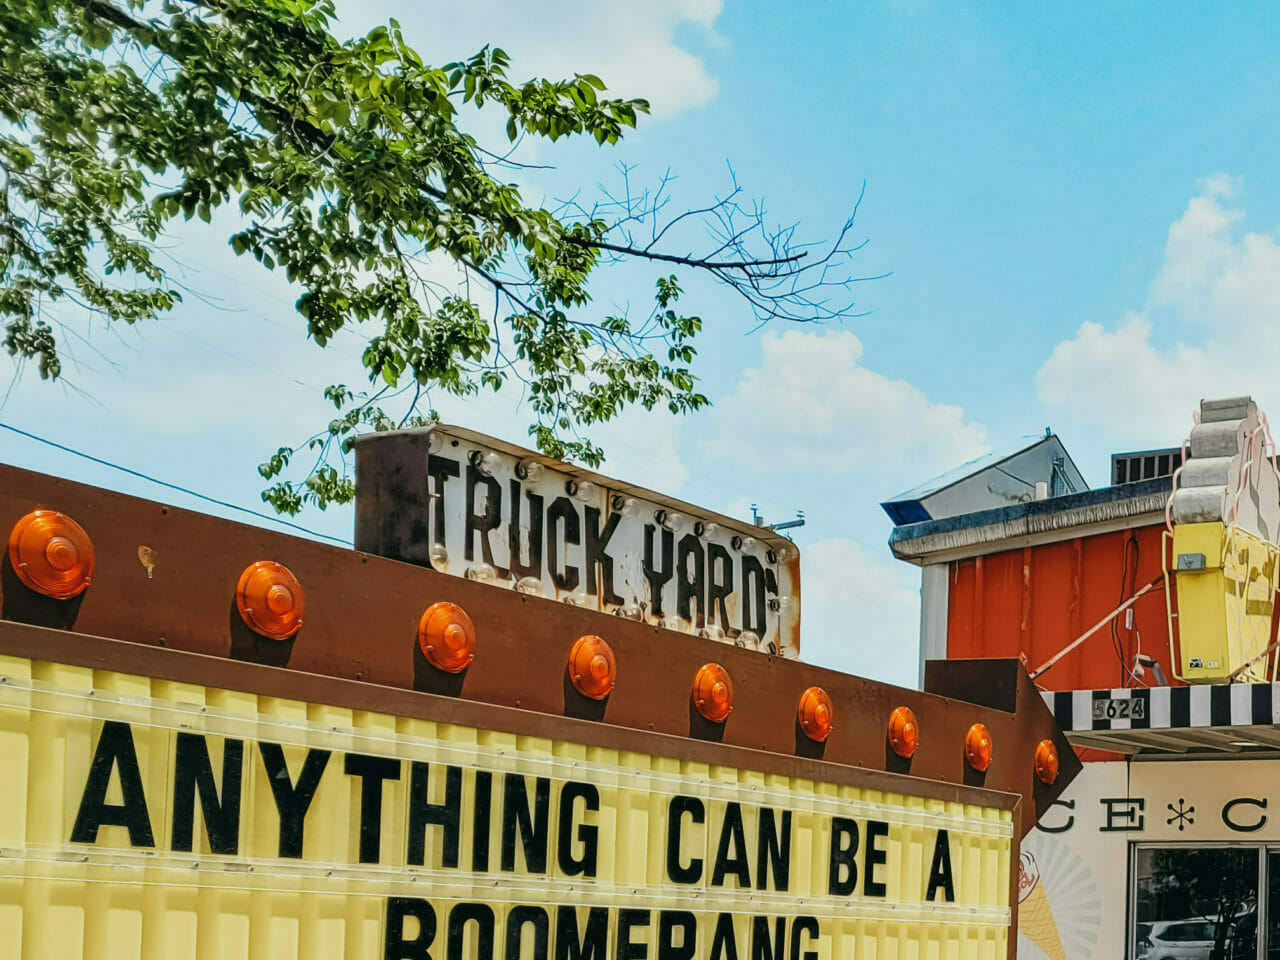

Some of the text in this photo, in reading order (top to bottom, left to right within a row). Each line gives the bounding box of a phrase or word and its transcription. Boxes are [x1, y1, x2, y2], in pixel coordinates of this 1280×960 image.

[427, 454, 768, 643] TRUCK YARD
[70, 720, 955, 902] ANYTHING CAN BE A
[1036, 797, 1145, 833] CE
